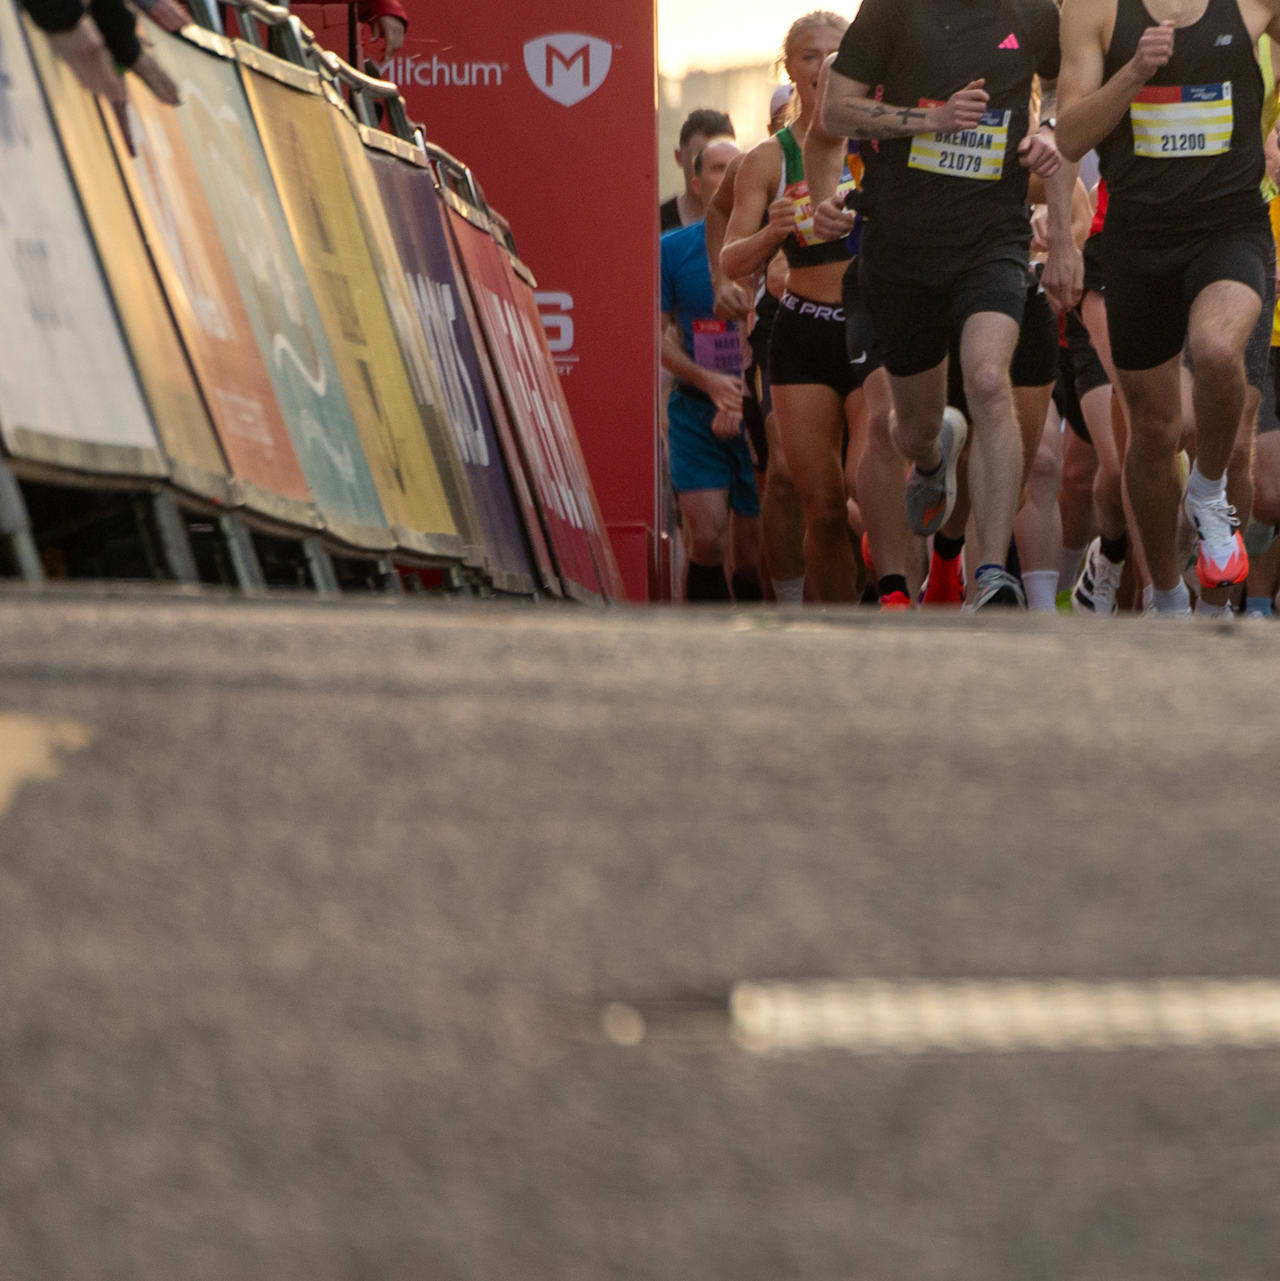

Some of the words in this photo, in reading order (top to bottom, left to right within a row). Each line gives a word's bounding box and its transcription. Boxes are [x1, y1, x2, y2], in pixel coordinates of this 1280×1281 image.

[935, 129, 994, 150] BRENDAN
[1160, 133, 1206, 152] 21200
[938, 151, 983, 173] 21079
